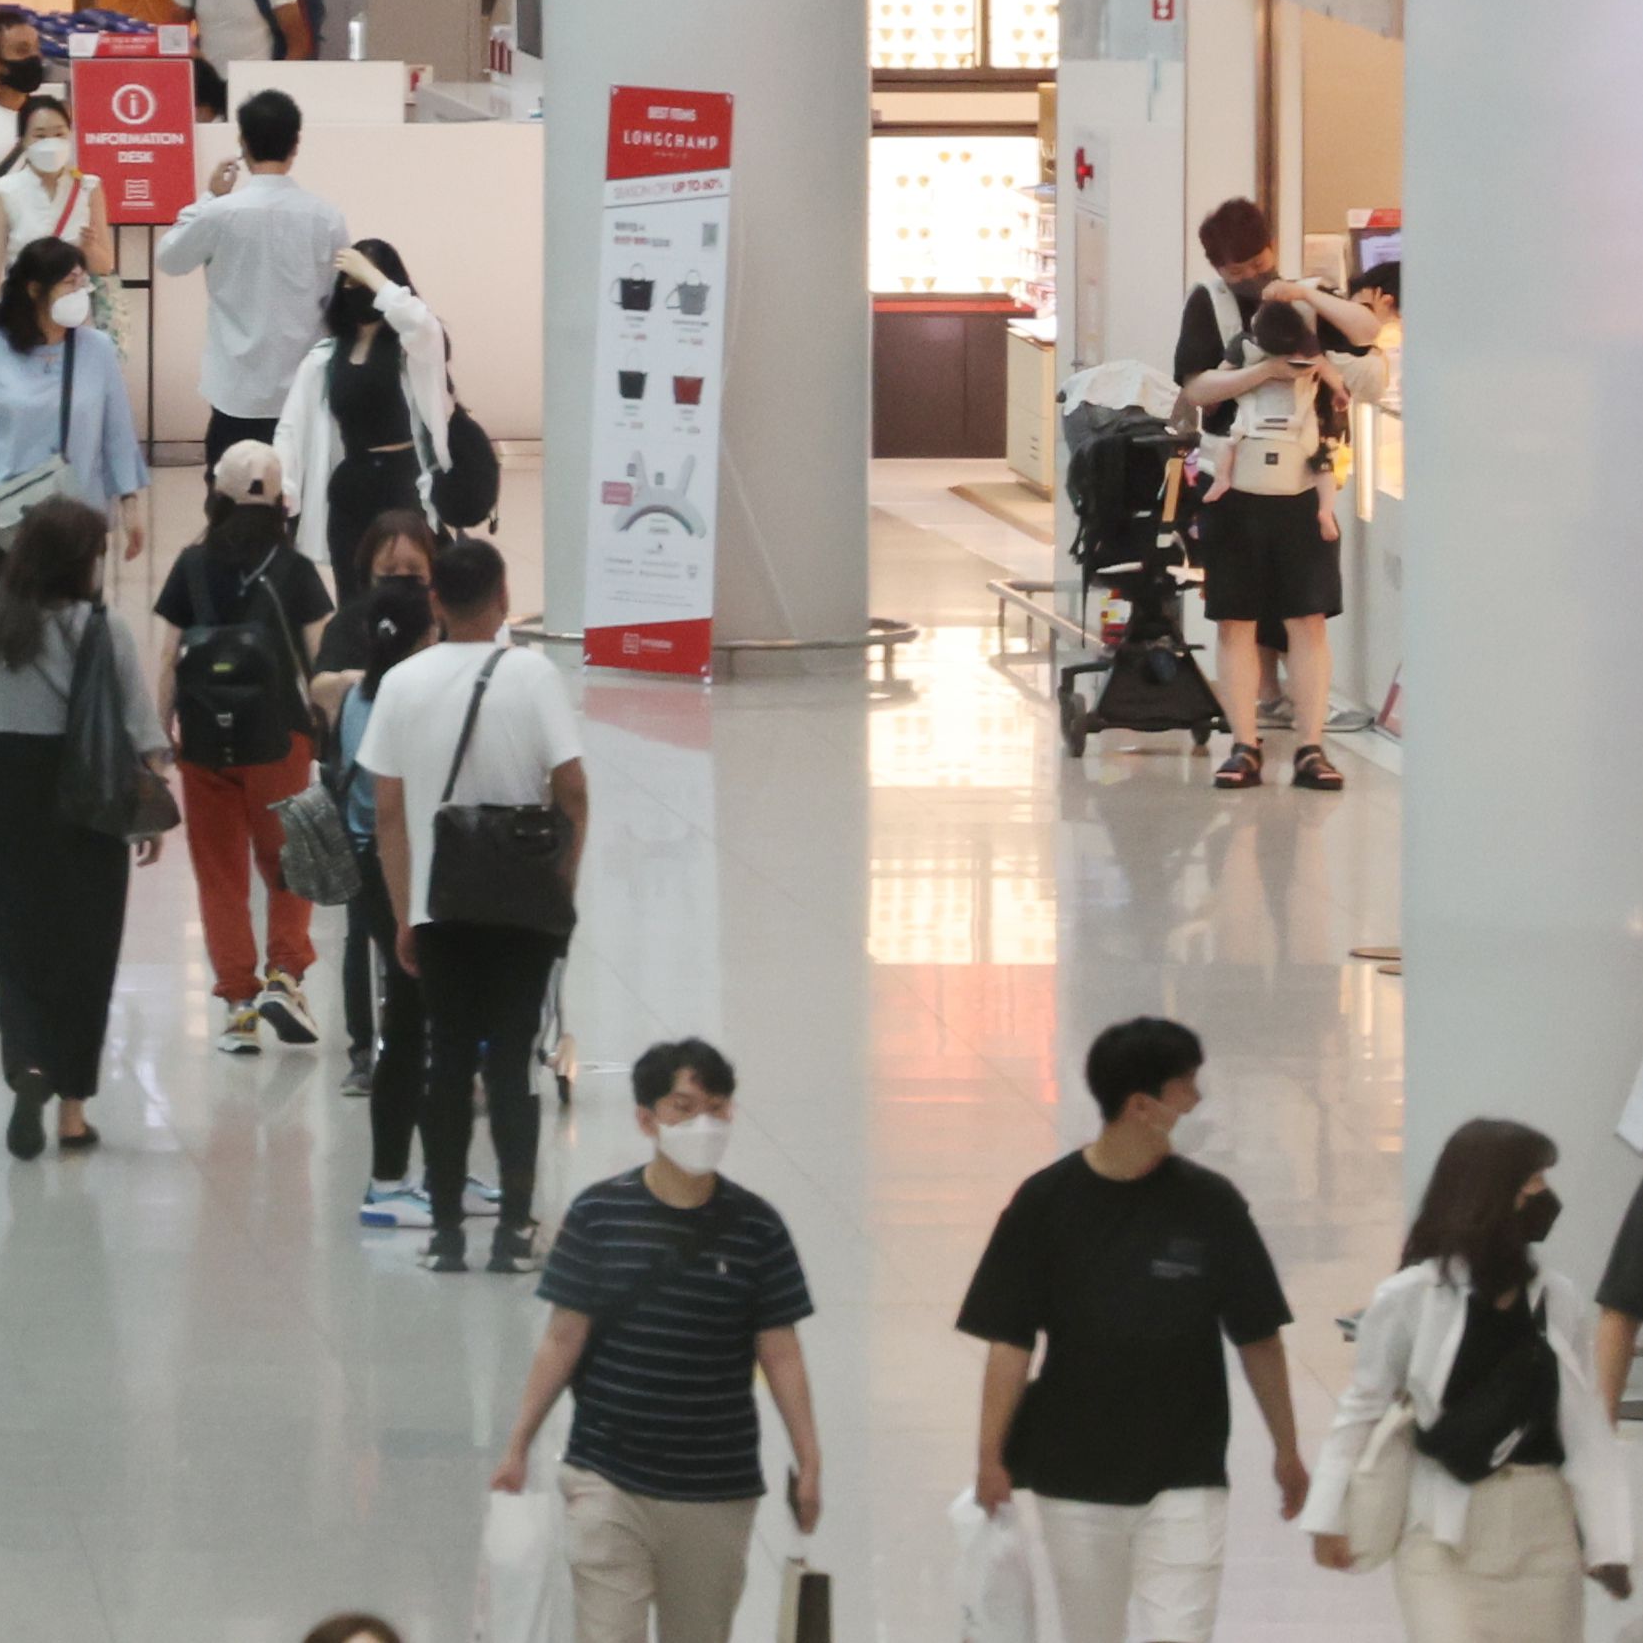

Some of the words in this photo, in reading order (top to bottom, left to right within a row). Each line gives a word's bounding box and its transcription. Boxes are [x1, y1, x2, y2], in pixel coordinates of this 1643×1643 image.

[85, 132, 184, 145] INFORMATION
[623, 130, 720, 150] LONGCHAMP
[117, 151, 154, 163] DESK
